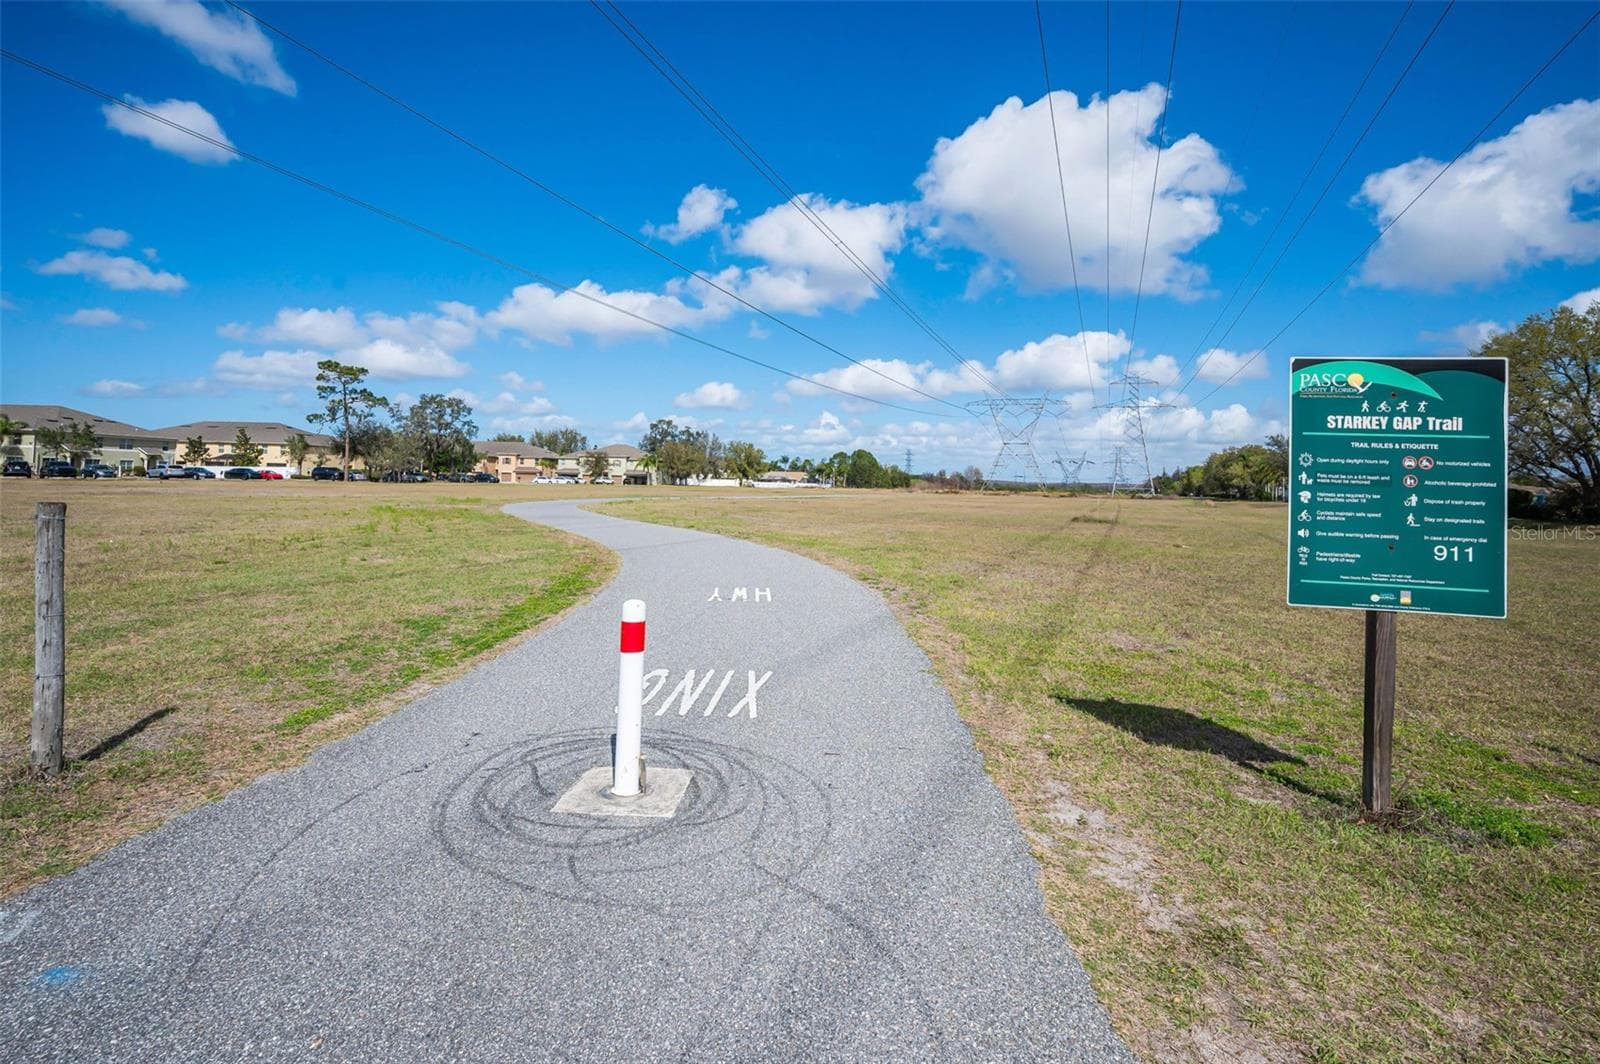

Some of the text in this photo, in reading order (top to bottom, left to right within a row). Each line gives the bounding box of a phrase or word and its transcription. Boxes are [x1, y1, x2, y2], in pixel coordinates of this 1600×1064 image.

[1327, 415, 1463, 431] STARKEY GAP Trail
[1434, 545, 1473, 562] 911
